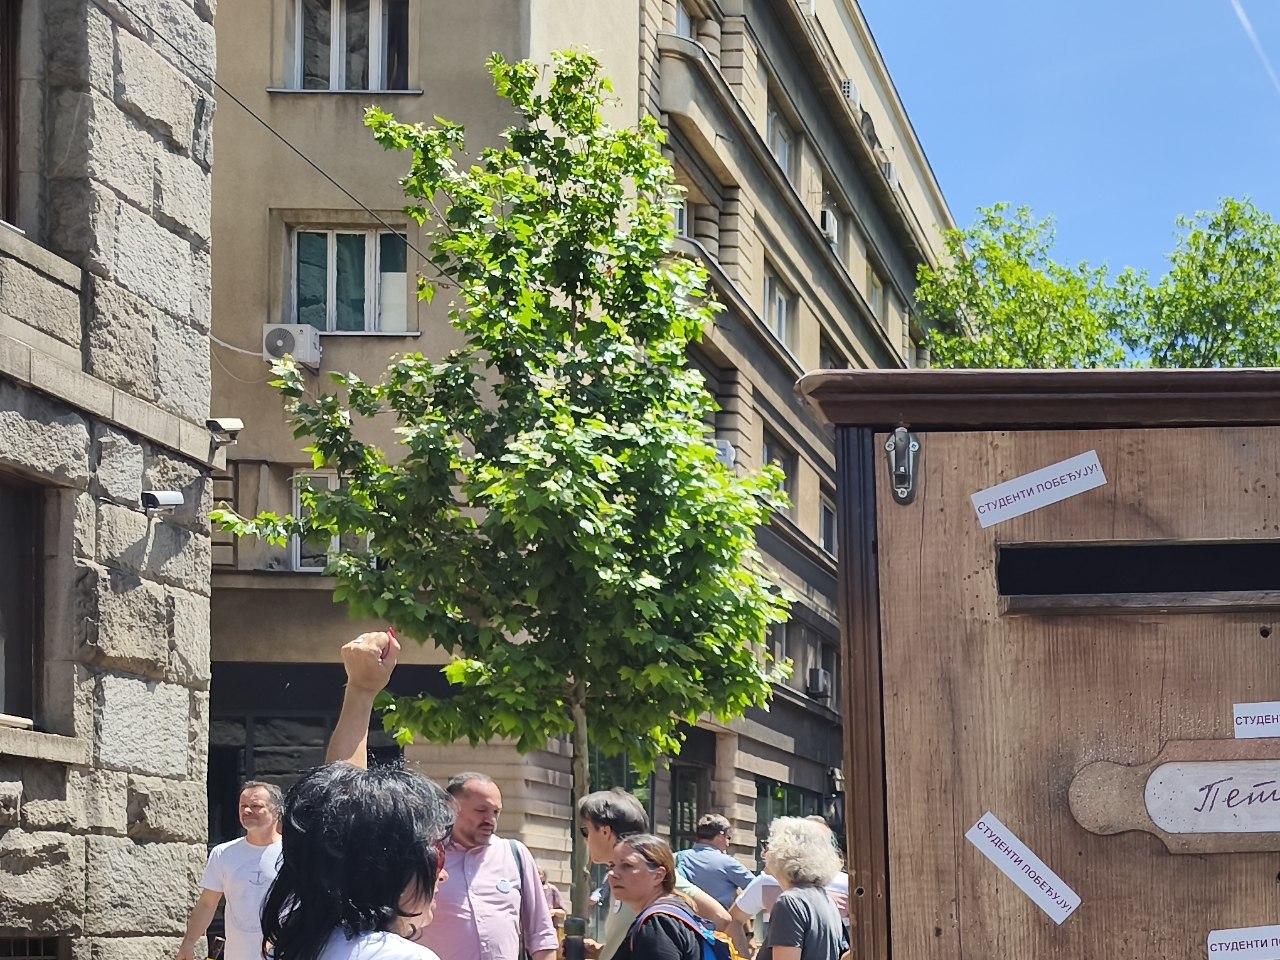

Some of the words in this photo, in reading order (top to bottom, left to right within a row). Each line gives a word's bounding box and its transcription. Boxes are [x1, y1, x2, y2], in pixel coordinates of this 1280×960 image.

[977, 487, 1035, 514] СТУДЕНТИ
[1036, 463, 1099, 493] ПОБЕЂУЈУ!
[977, 821, 1023, 866] СТУДЕНТИ
[1021, 864, 1072, 913] ПОБЕЂУЈУ!
[1210, 939, 1268, 952] СТУДЕНТИ
